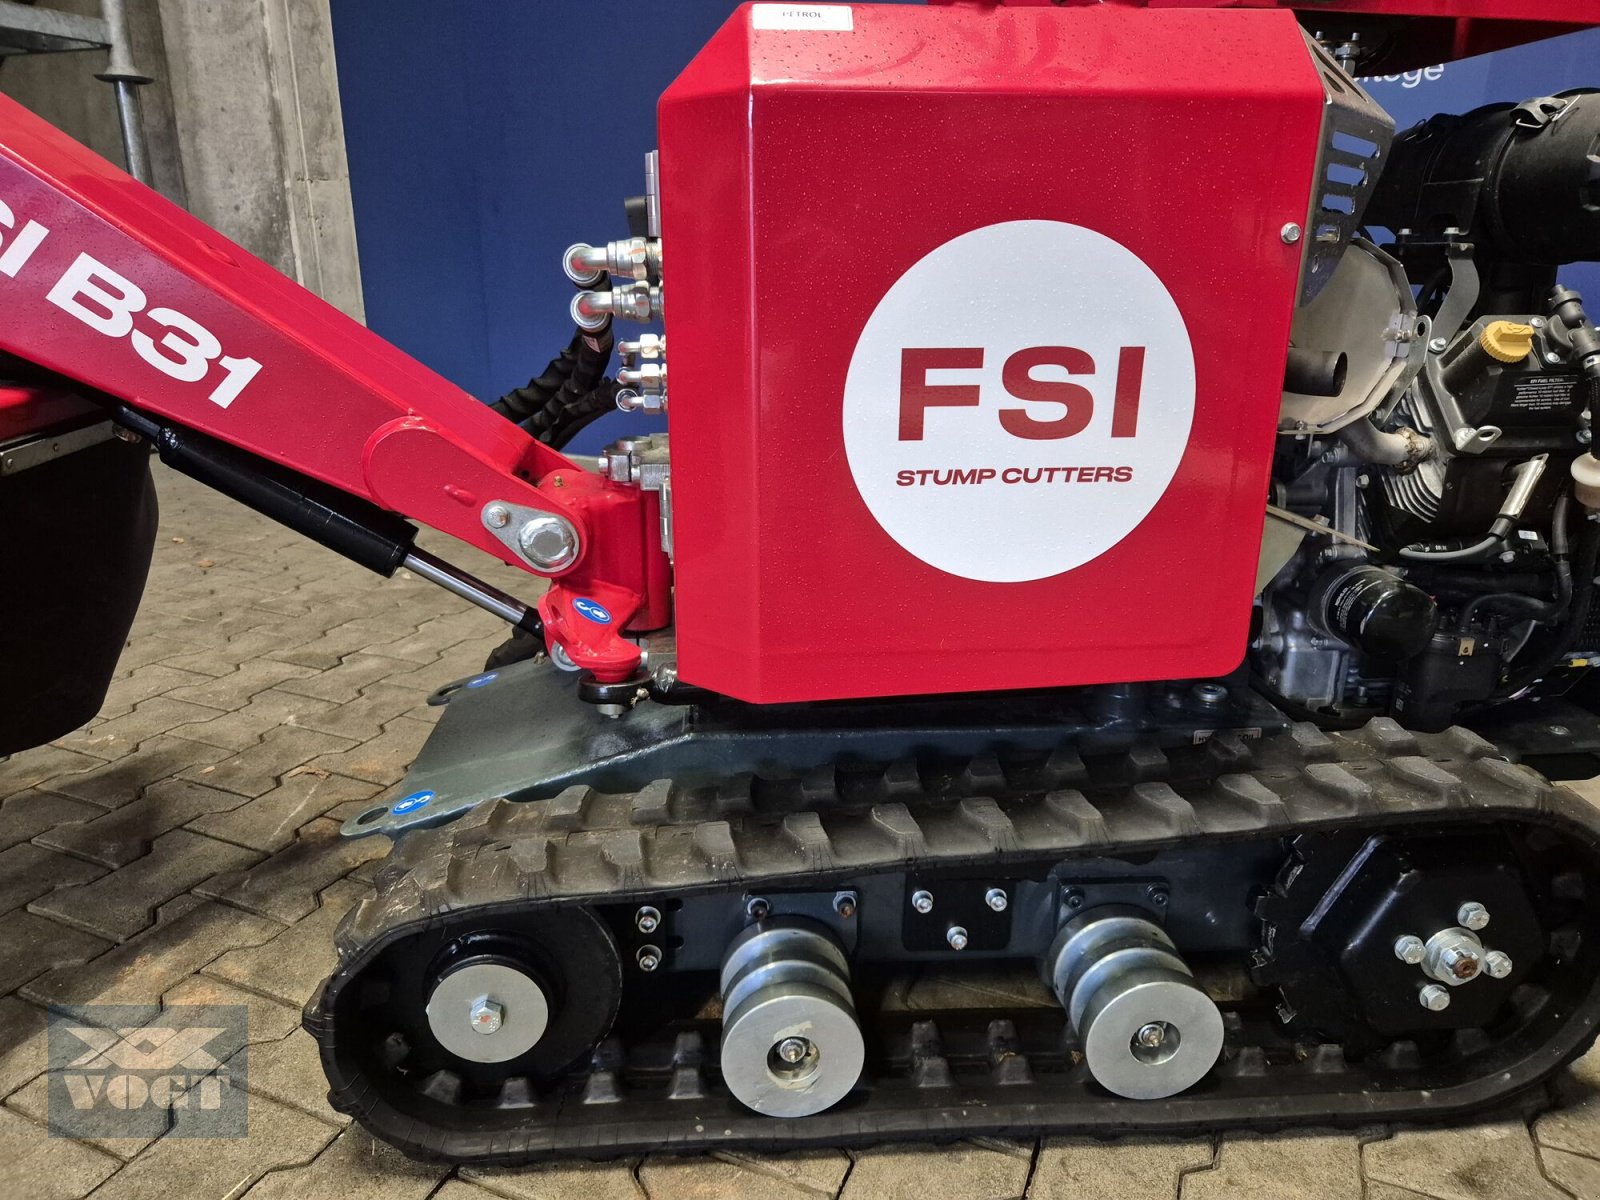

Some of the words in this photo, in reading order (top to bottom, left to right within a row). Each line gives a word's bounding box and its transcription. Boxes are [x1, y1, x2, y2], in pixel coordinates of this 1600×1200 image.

[45, 251, 263, 409] B31
[898, 346, 1146, 441] FSI
[896, 468, 996, 486] STUMP
[1001, 466, 1134, 484] CUTTERS
